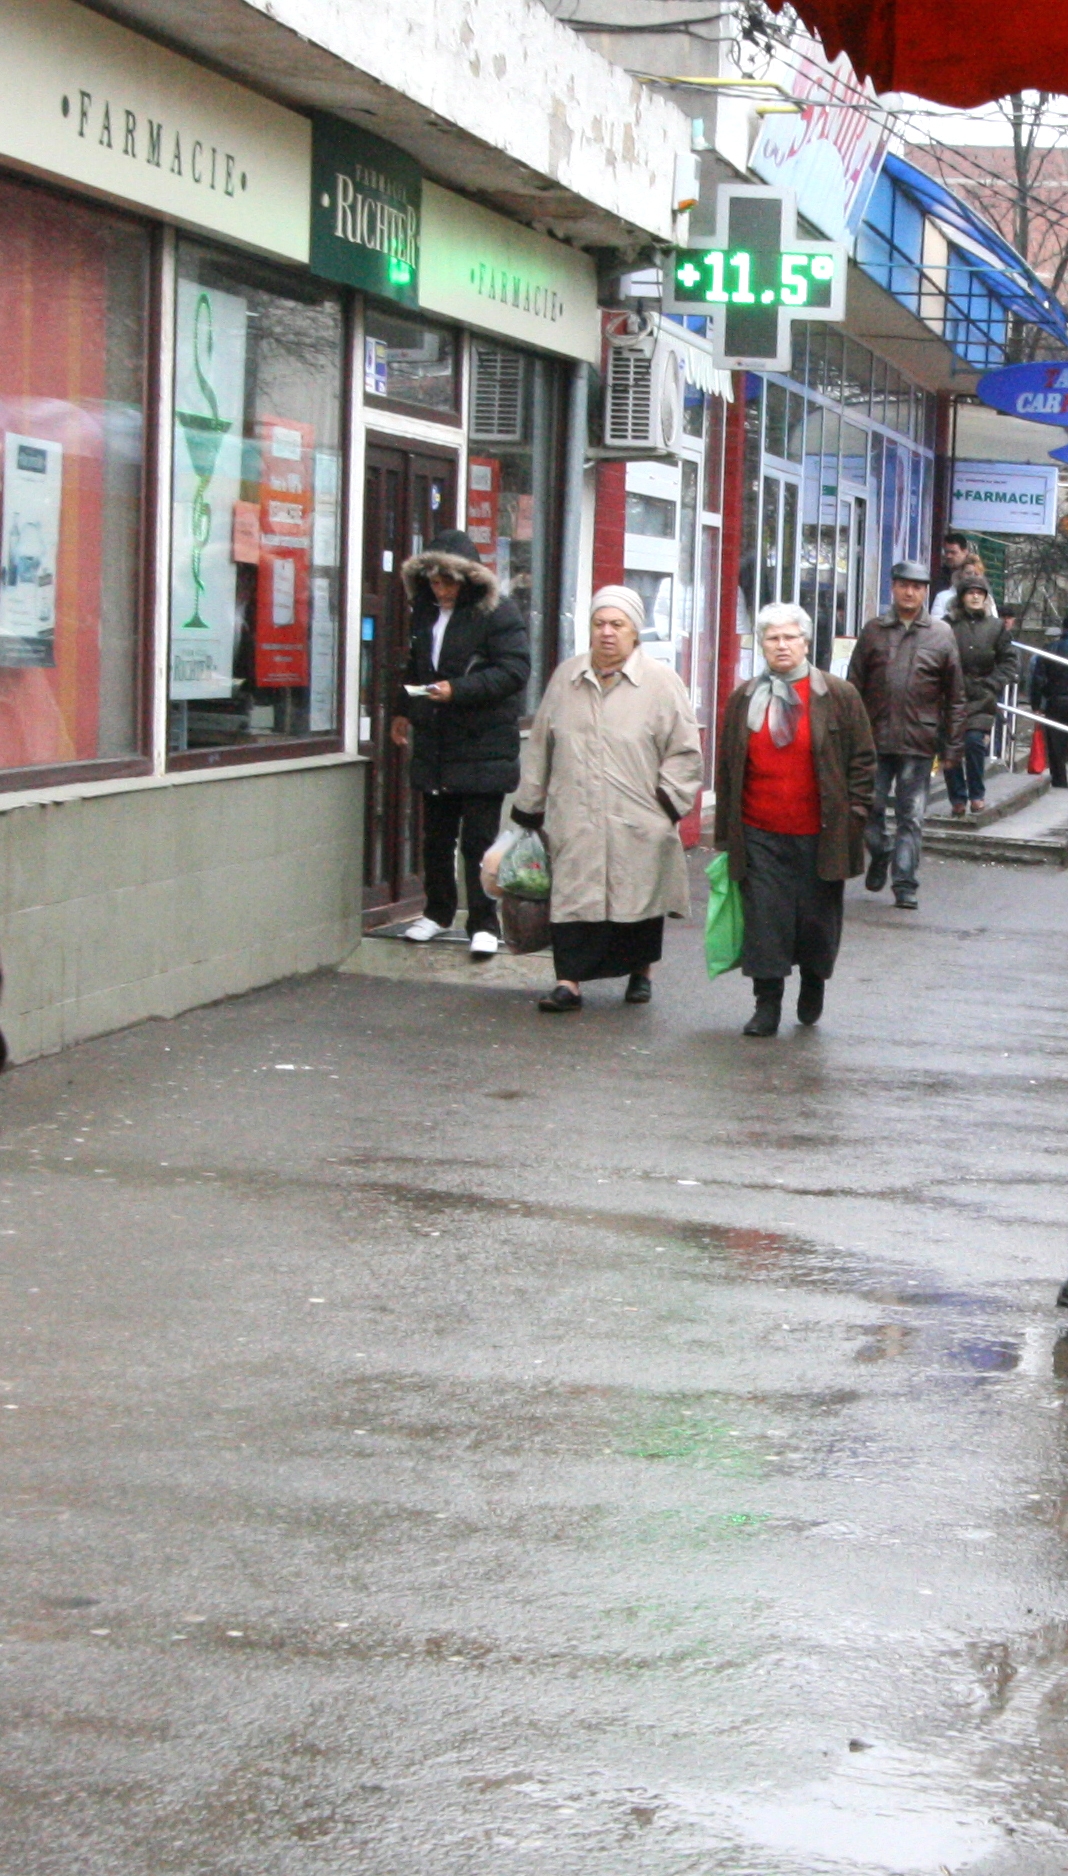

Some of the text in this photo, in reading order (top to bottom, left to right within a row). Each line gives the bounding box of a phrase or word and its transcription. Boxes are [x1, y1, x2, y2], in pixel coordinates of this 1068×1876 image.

[78, 89, 236, 198] FARMACIE
[334, 172, 416, 269] RICHTER
[479, 263, 557, 322] FARMACIE
[964, 490, 1045, 506] FARMACIE
